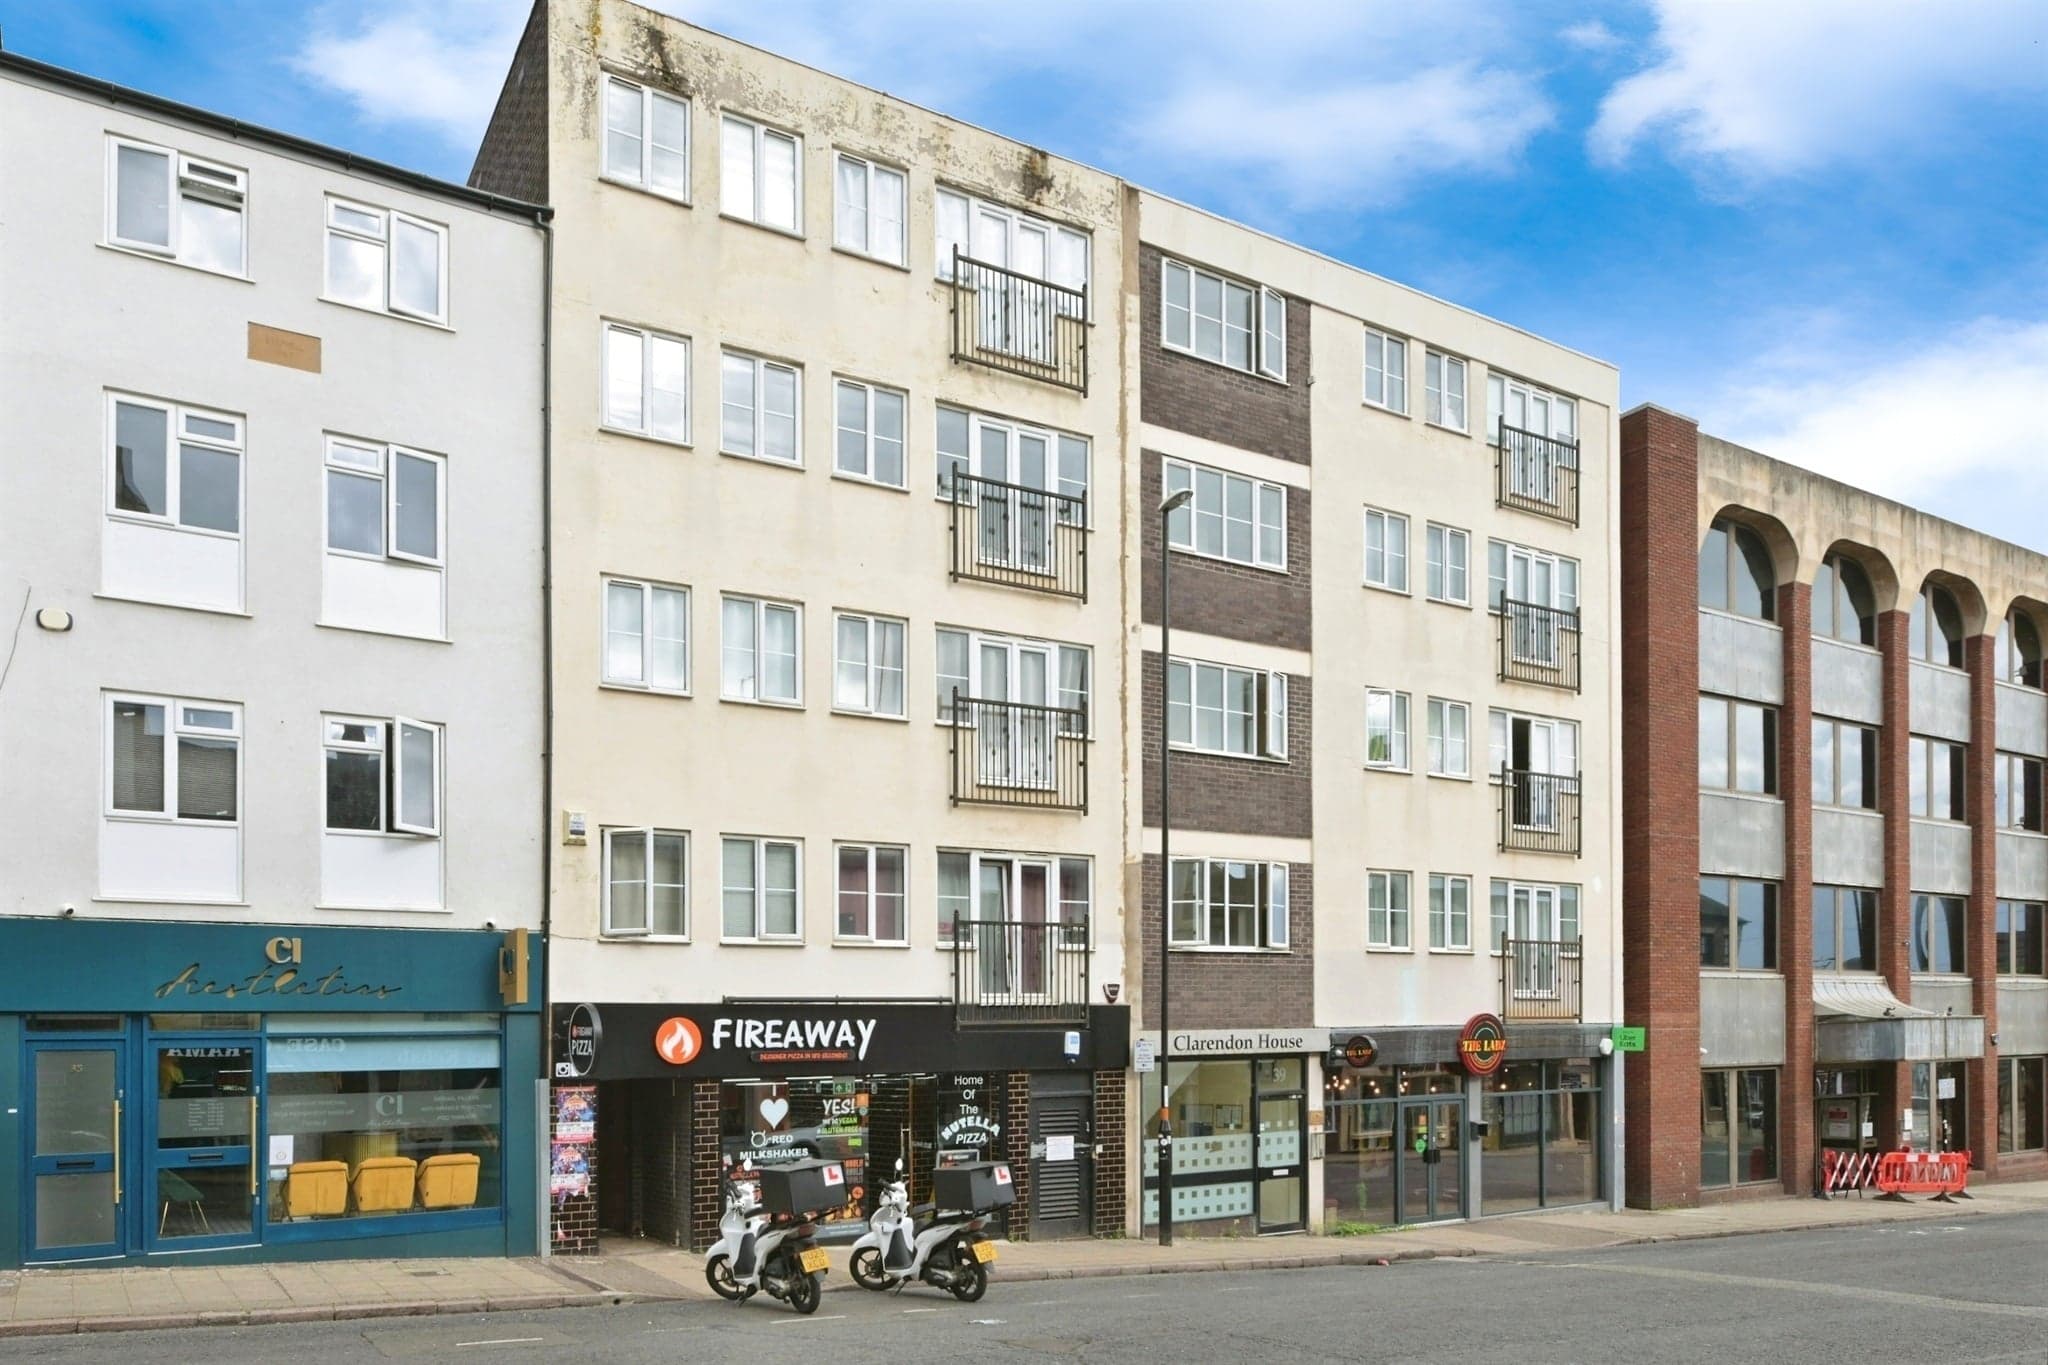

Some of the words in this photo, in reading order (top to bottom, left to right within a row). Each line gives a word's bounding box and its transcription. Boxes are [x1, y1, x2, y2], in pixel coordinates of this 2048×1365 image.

[712, 1018, 877, 1061] FIREAWAY
[1174, 1034, 1253, 1051] Clarendon
[1259, 1034, 1303, 1049] House
[572, 1039, 593, 1056] PIZZA
[954, 1075, 984, 1086] Home
[1272, 1067, 1286, 1083] 39
[963, 1089, 976, 1100] Of
[822, 1098, 856, 1115] YES!
[959, 1104, 979, 1115] The
[941, 1116, 1001, 1141] NUTELLA
[955, 1132, 987, 1145] PIZZA
[739, 1148, 809, 1160] MILKSHAKES
[827, 1167, 839, 1181] L
[998, 1167, 1008, 1180] L
